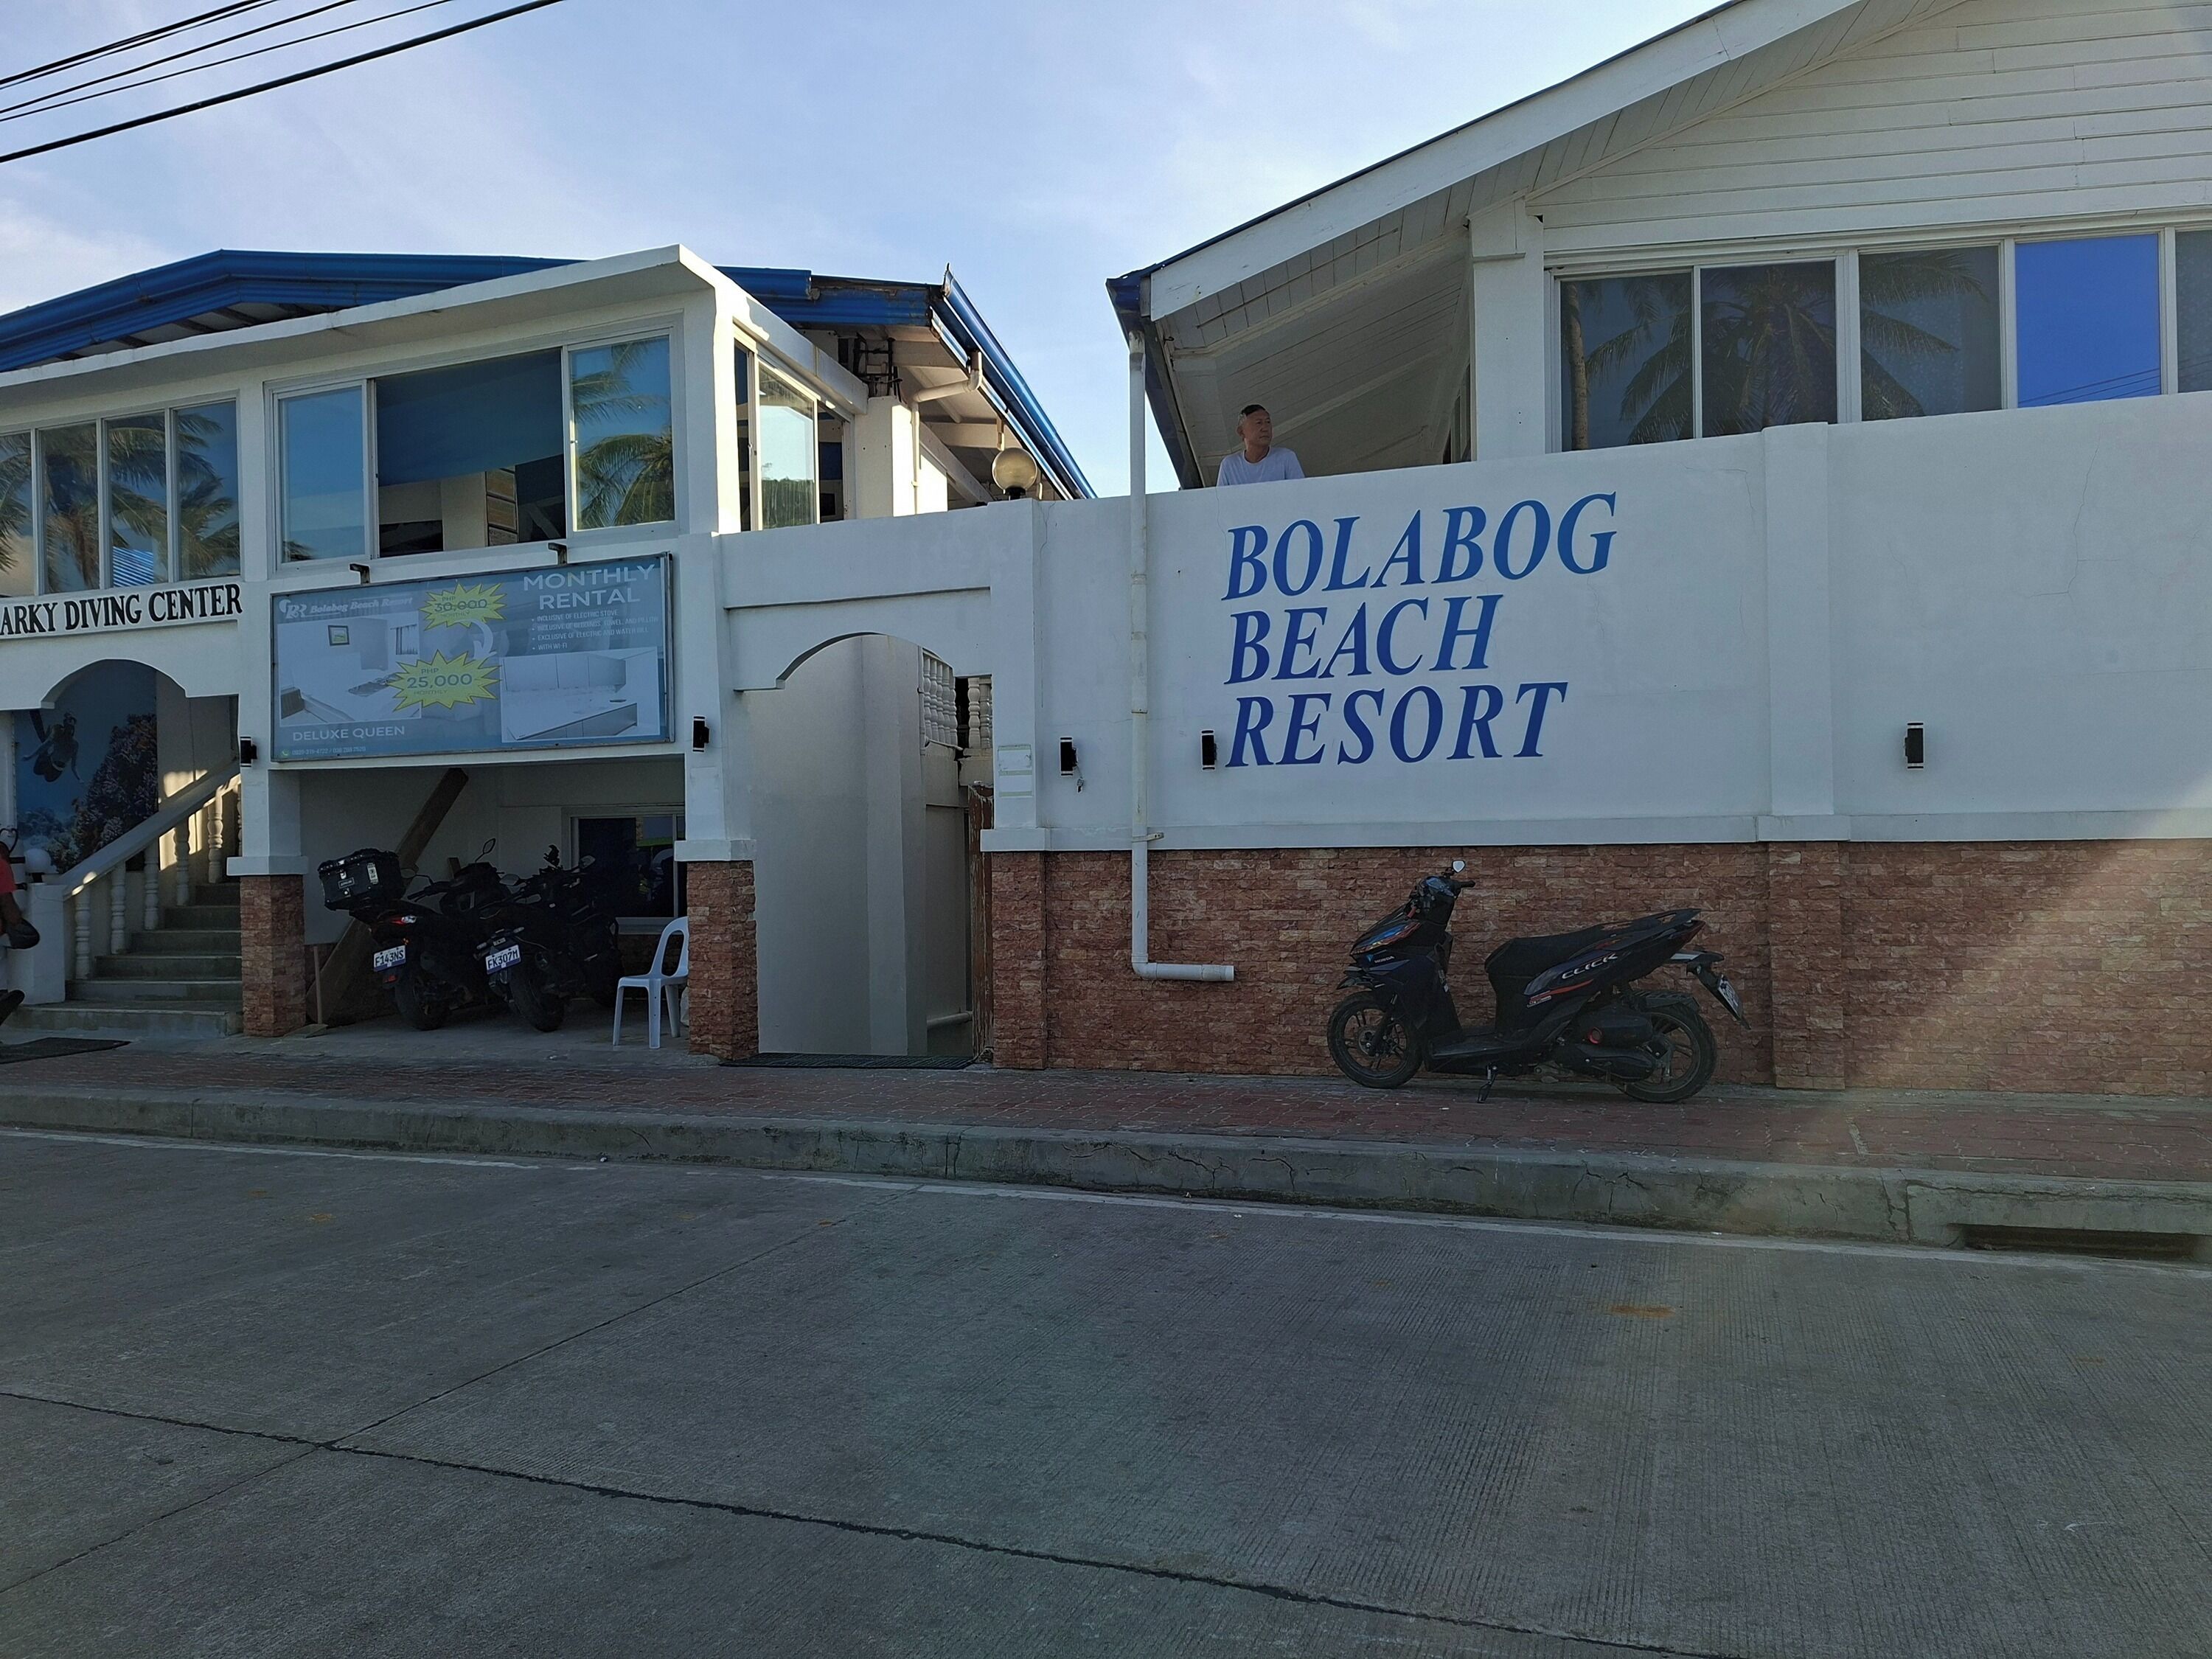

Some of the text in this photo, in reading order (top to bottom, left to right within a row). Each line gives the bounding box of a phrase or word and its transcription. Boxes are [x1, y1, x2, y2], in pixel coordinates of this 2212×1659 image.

[1221, 491, 1617, 601] BOLABOG
[524, 564, 655, 591] MONTHLY
[64, 593, 142, 630] DIVING
[148, 583, 243, 622] CENTER
[310, 604, 349, 614] Bolabog
[349, 599, 380, 611] Beach
[540, 588, 641, 610] RENTAL
[537, 613, 563, 622] INCLUSIVE
[574, 611, 599, 619] ELECTRIC
[538, 632, 567, 641] EXCLUSIVE
[1222, 594, 1503, 685] BEACH
[407, 673, 473, 689] 25,000
[293, 726, 405, 741] DELUXE QUEEN
[1224, 681, 1569, 768] RESORT
[375, 949, 404, 967] F143NS
[487, 949, 519, 969] FK307M
[1562, 953, 1618, 979] CLICK
